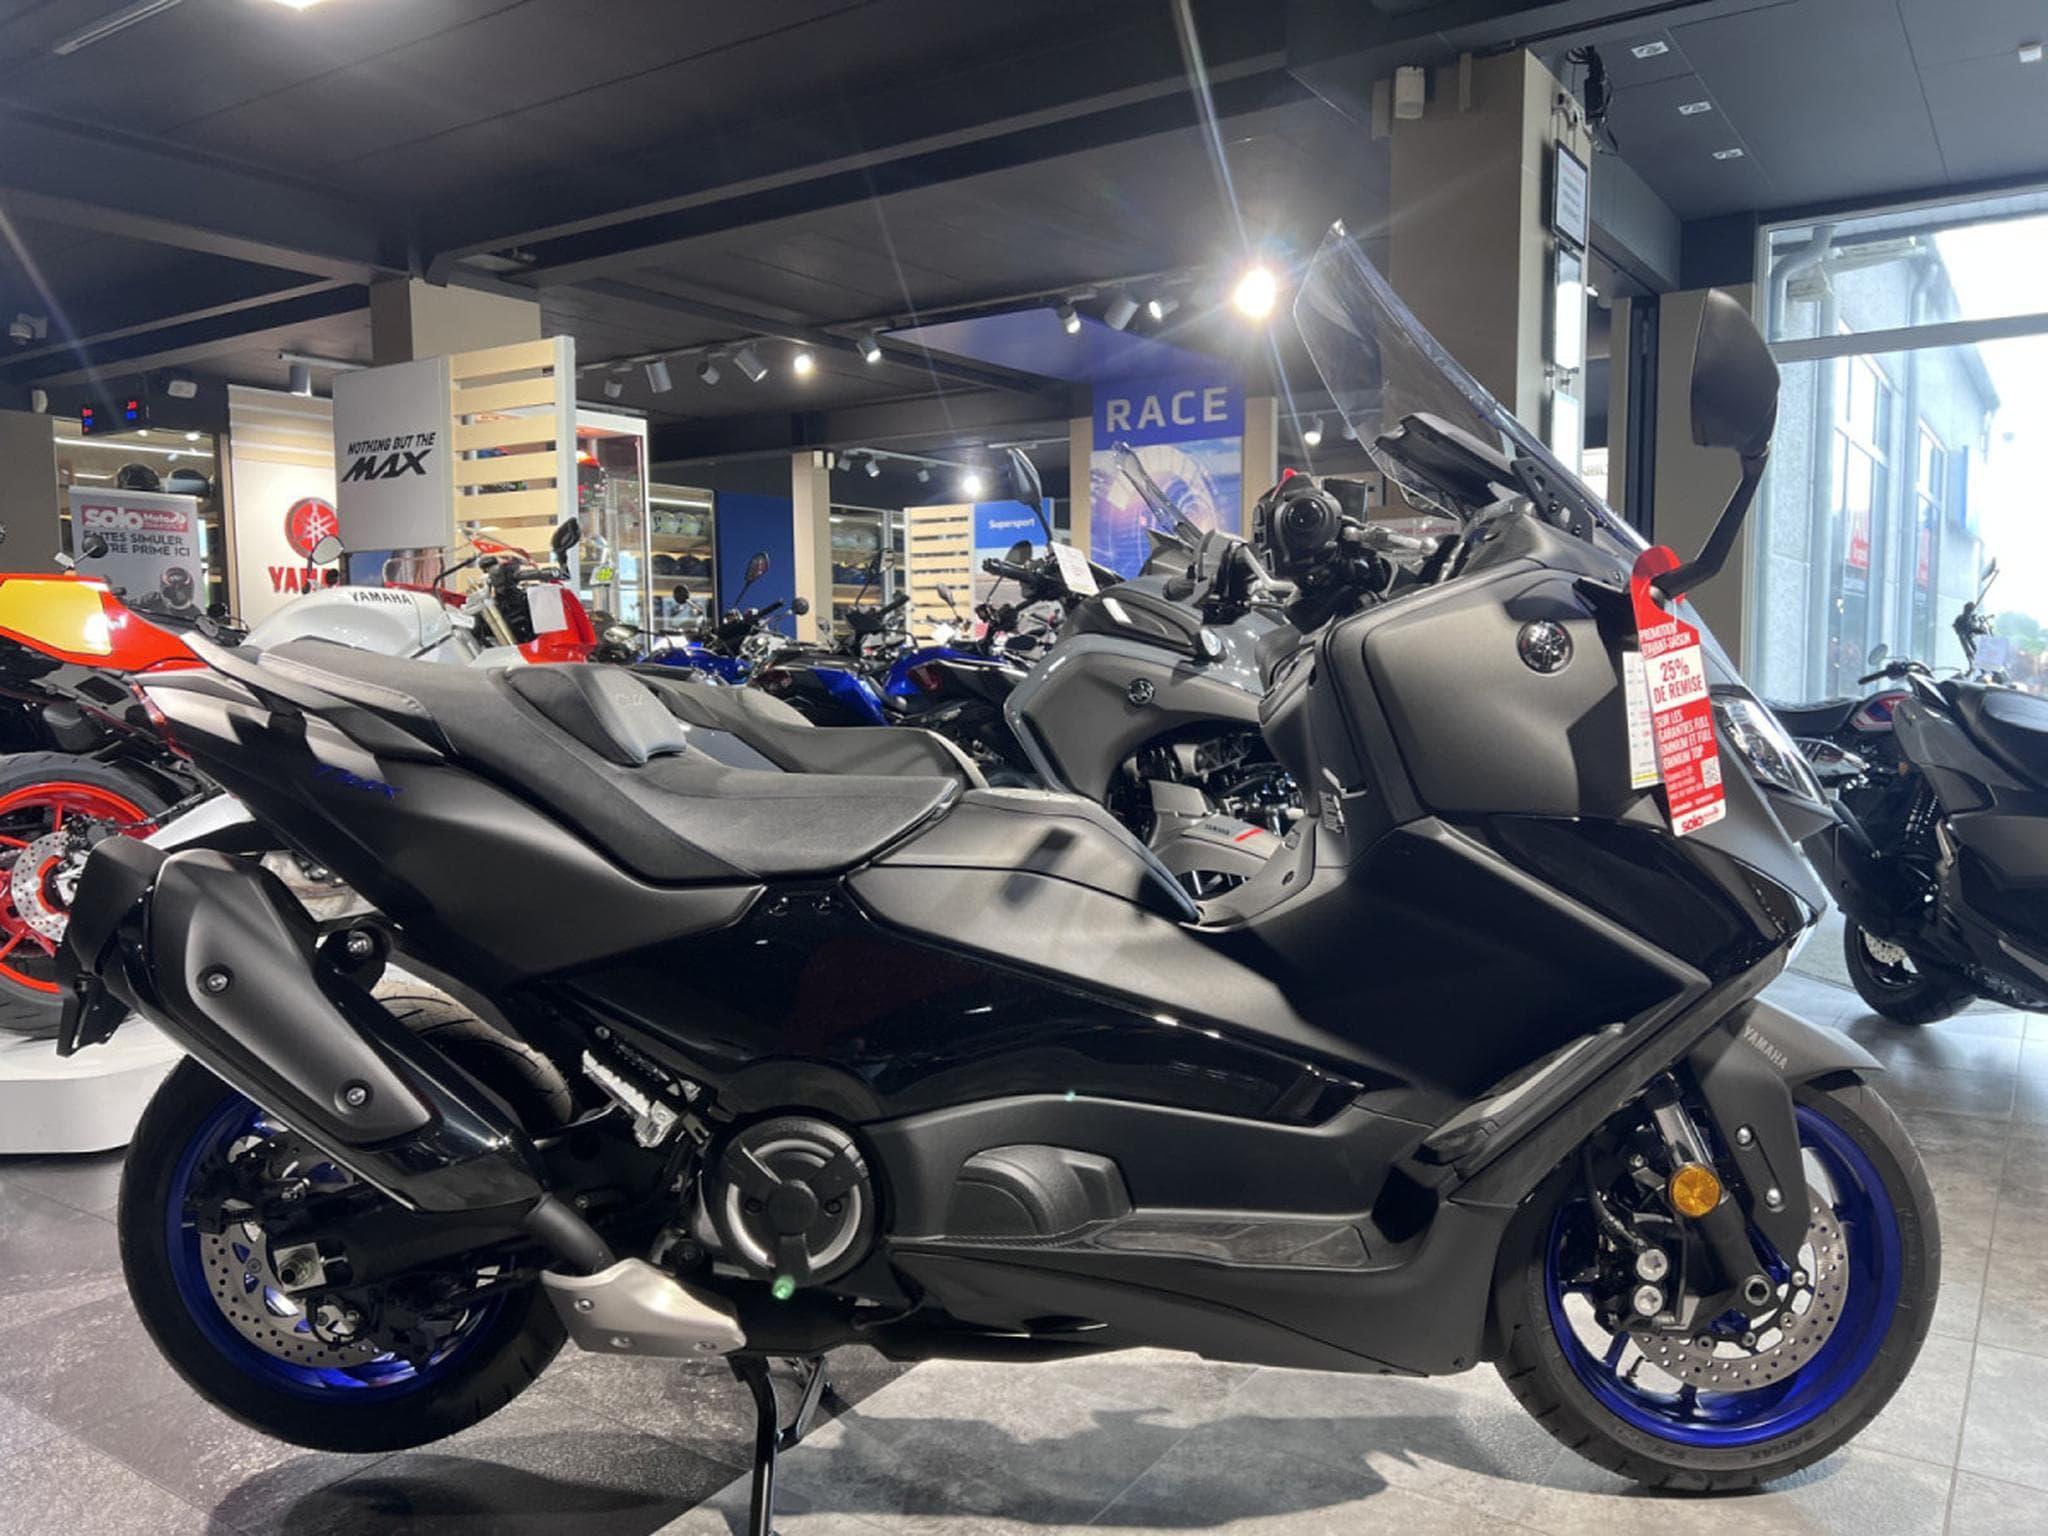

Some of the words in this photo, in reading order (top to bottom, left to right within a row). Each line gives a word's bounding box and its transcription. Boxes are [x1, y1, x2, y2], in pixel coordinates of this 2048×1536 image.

[1106, 386, 1228, 433] RACE
[347, 437, 392, 455] NOTHING
[392, 435, 414, 450] BUT
[415, 432, 437, 447] THE
[340, 448, 432, 483] MAX
[988, 518, 1035, 531] Supersport
[130, 533, 183, 545] SIMULER
[132, 543, 170, 556] PRIME
[175, 547, 190, 557] ICI
[351, 591, 413, 606] YAMAHA
[1660, 657, 1690, 682] 25%
[1653, 686, 1668, 704] DE
[1668, 674, 1703, 698] REMISE
[1671, 709, 1684, 724] LES
[1743, 1025, 1788, 1070] YAMAHA
